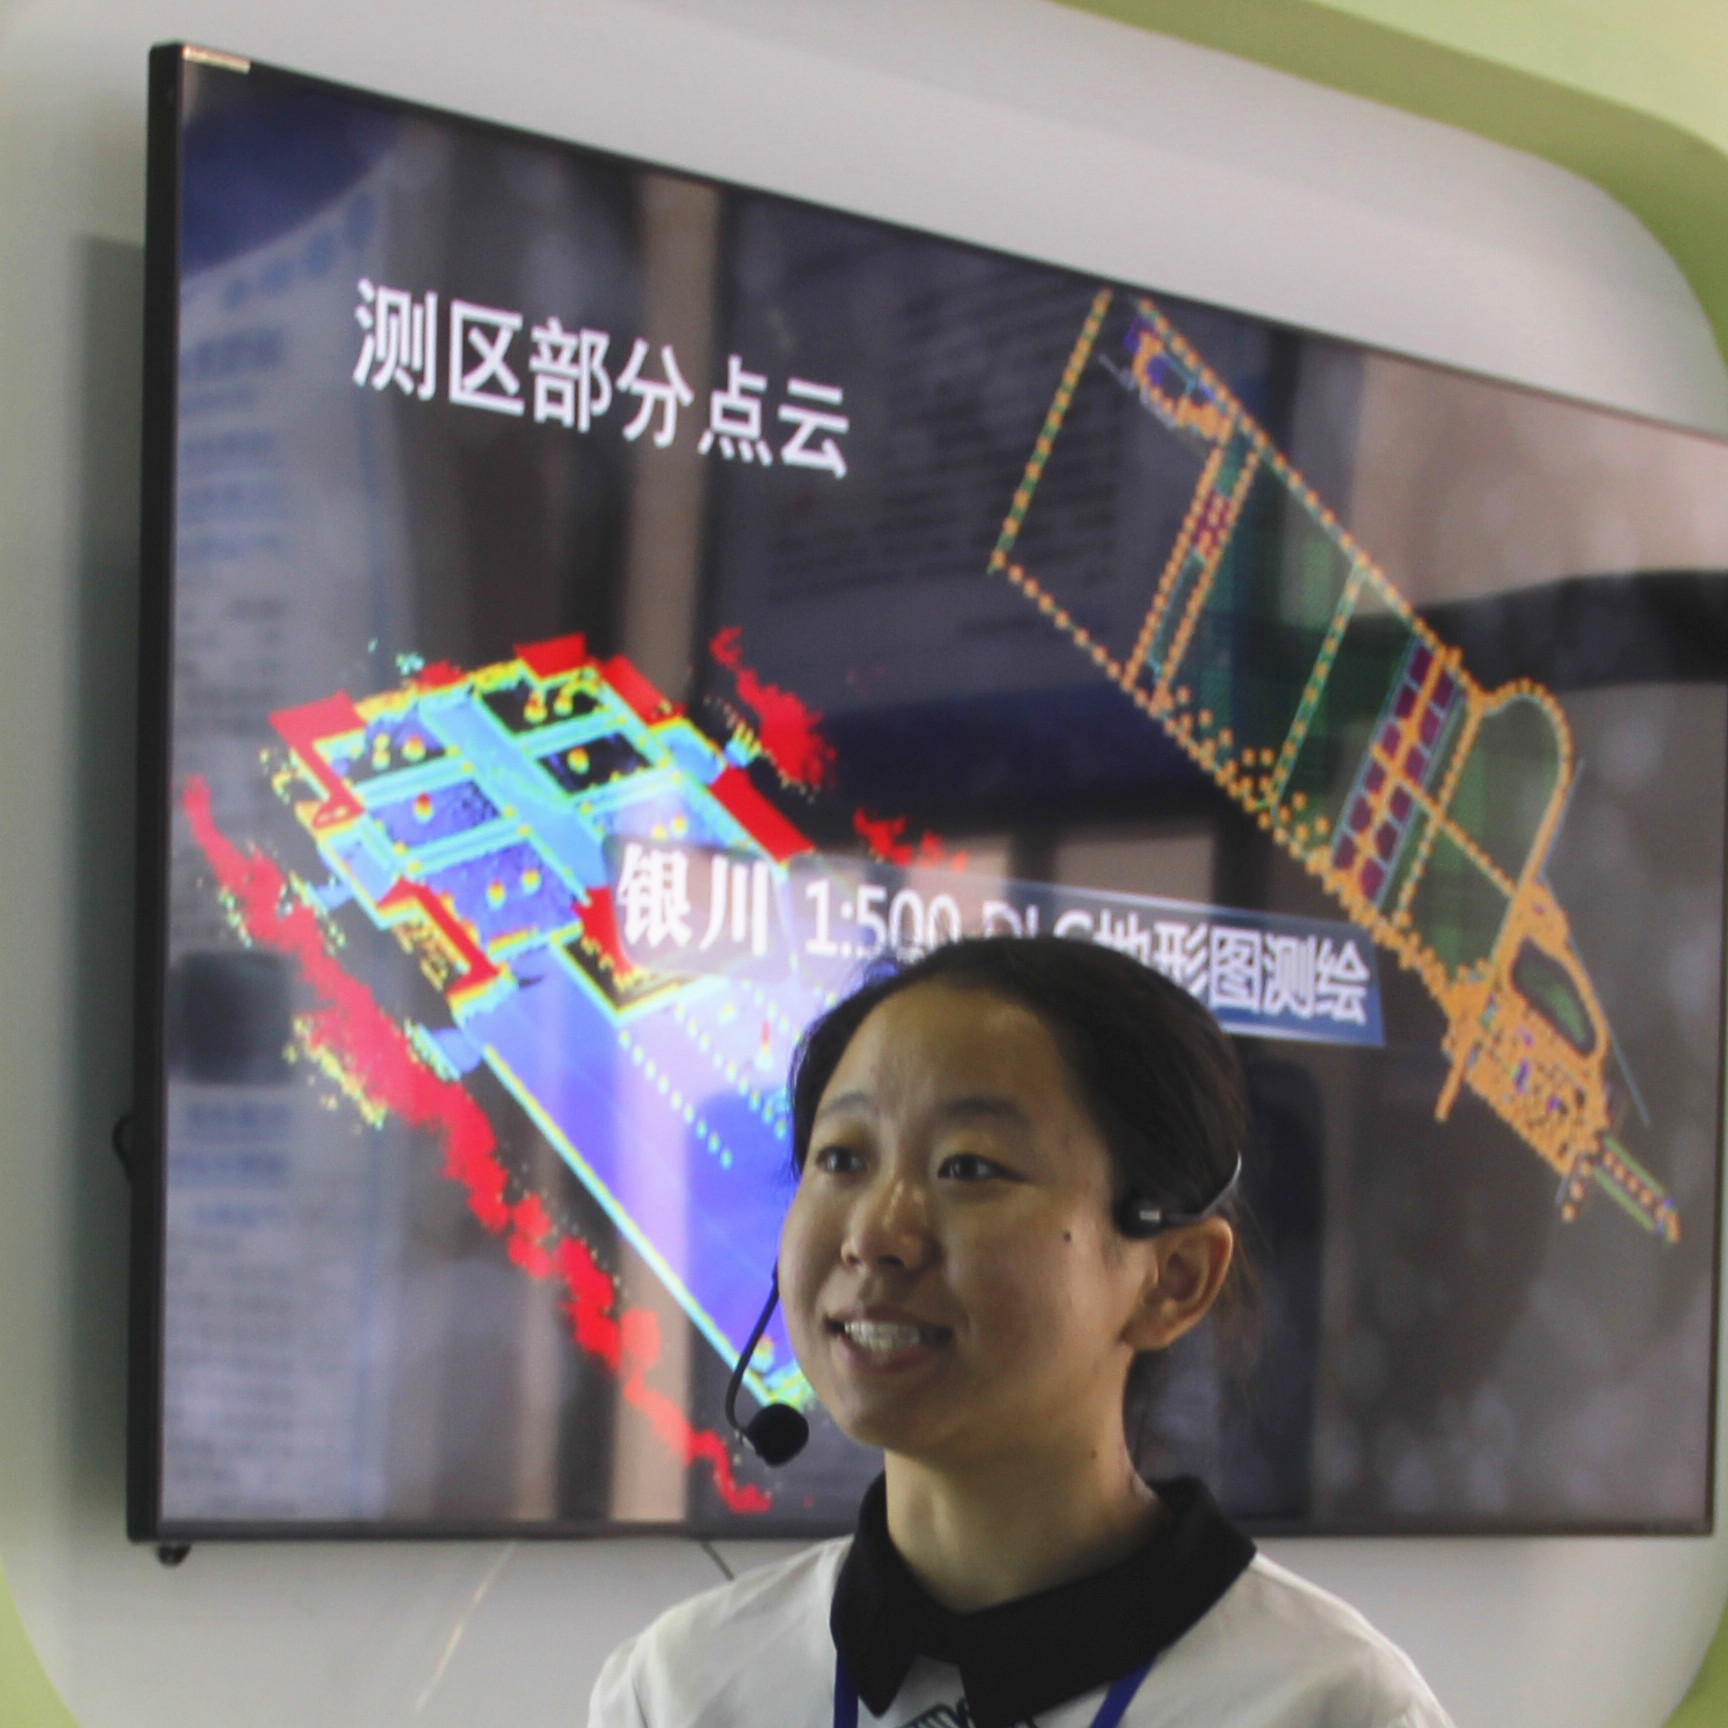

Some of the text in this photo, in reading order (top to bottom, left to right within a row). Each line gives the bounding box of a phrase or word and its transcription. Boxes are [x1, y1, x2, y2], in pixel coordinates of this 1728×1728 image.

[353, 278, 850, 479] 测区部分点云
[615, 842, 770, 956] 银川
